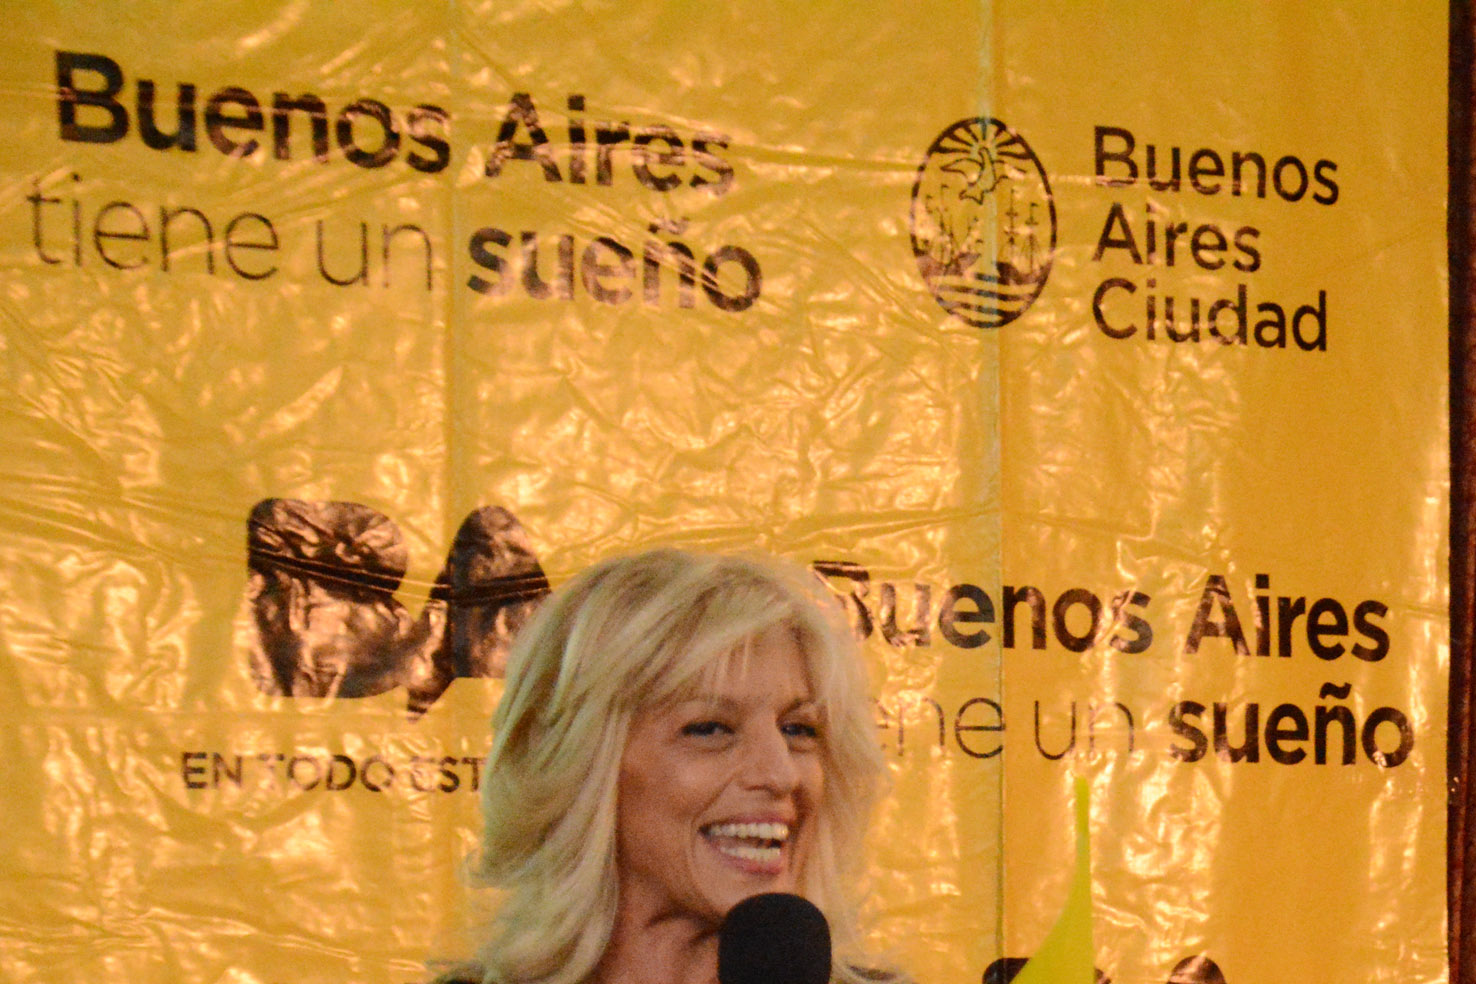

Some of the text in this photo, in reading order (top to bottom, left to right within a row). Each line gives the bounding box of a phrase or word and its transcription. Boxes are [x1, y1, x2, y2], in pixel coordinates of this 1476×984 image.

[55, 50, 735, 195] Buenos Aires
[1093, 125, 1339, 205] Buenos
[26, 172, 762, 313] tiene un sueño
[1091, 203, 1261, 273] Aires
[1091, 278, 1327, 352] Ciudad
[1186, 574, 1390, 662] Aires
[1034, 696, 1134, 760] un
[1170, 682, 1414, 768] sueño
[182, 752, 242, 789] EN
[410, 756, 487, 792] EST
